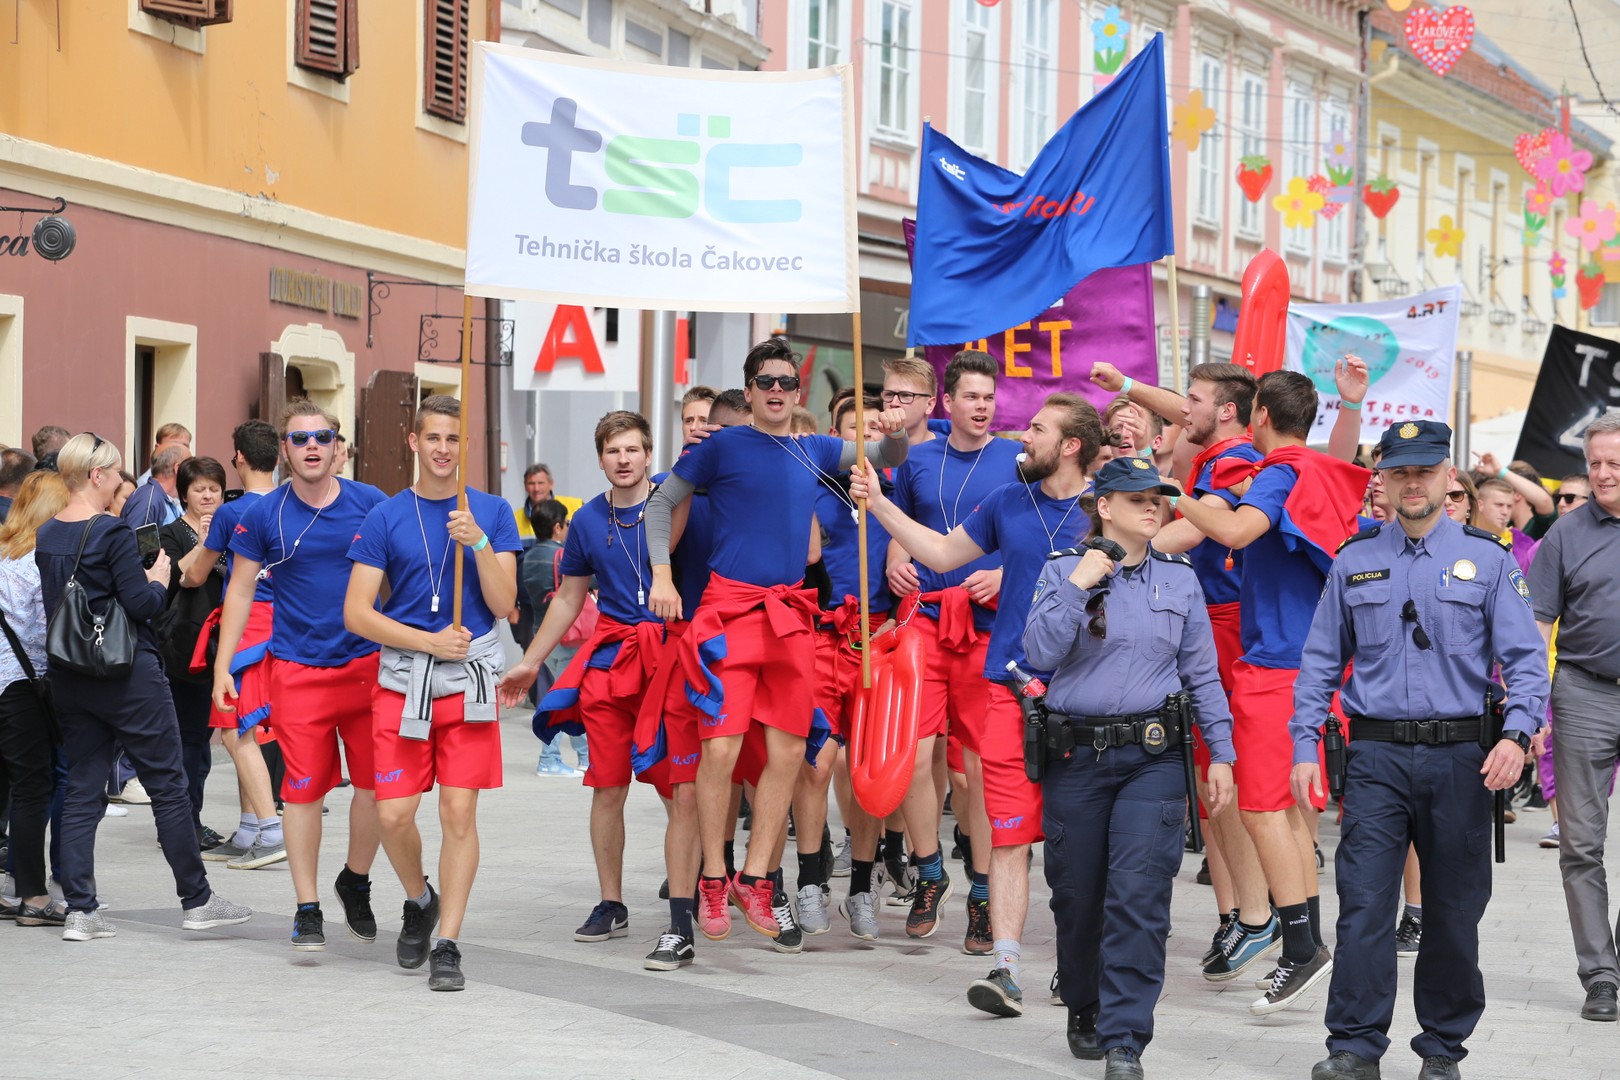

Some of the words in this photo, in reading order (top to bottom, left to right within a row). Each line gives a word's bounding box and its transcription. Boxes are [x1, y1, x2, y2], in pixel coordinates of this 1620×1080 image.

[515, 234, 620, 264] Tehnička
[628, 244, 692, 269] škola
[701, 245, 803, 271] Čakovec
[1406, 301, 1448, 319] 4.RT
[1404, 356, 1441, 380] 2019
[1352, 571, 1383, 582] POLICIJA
